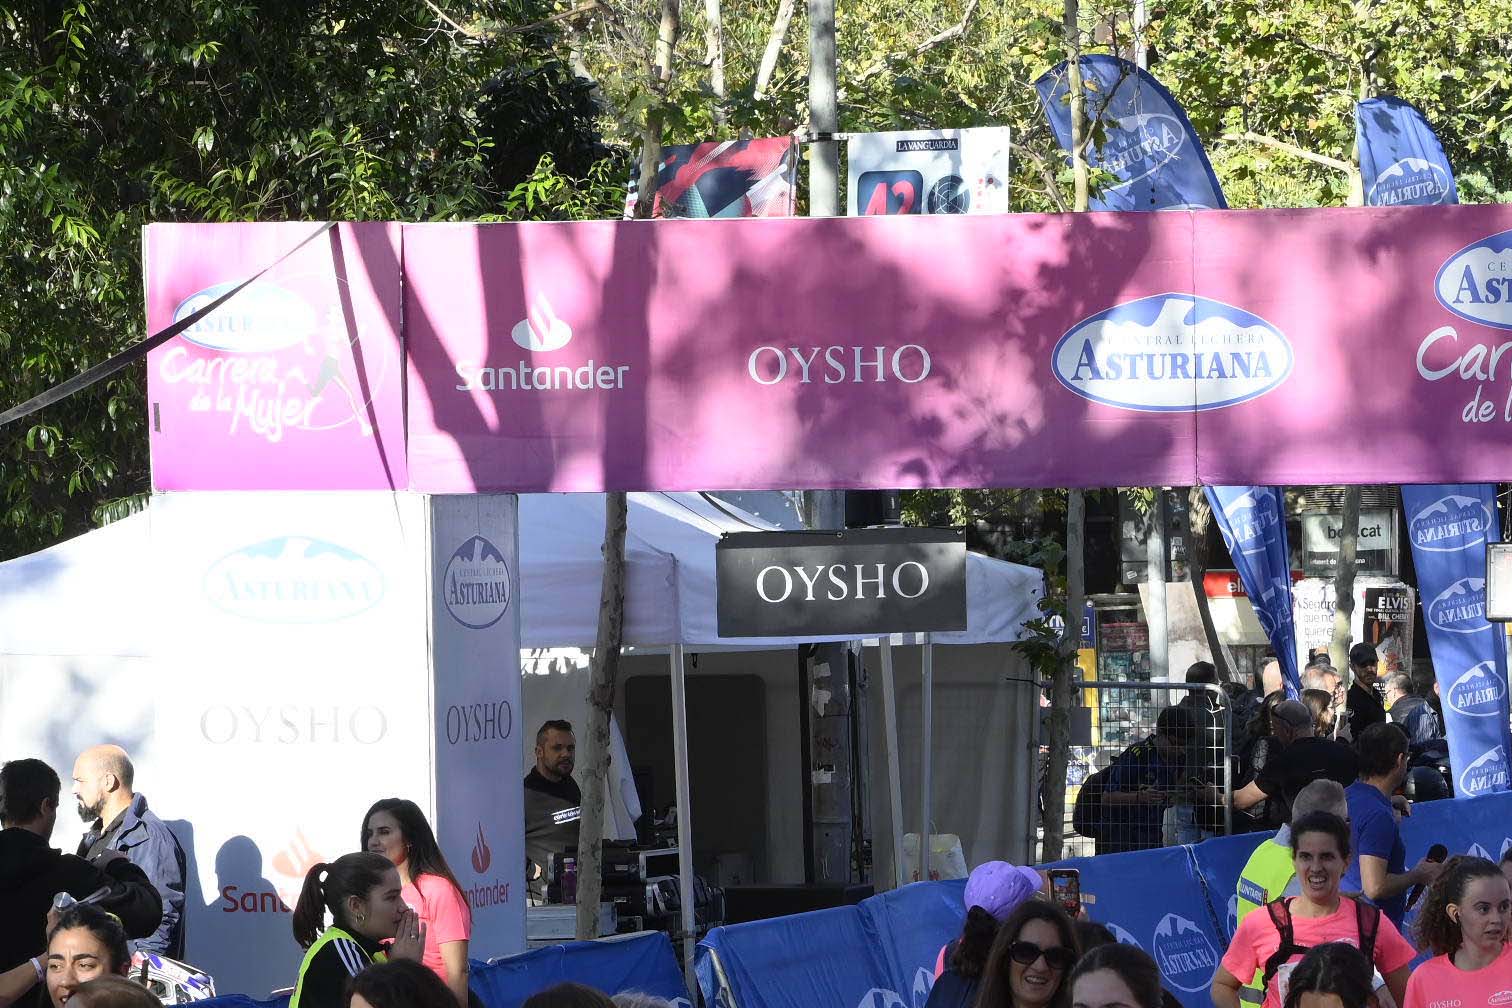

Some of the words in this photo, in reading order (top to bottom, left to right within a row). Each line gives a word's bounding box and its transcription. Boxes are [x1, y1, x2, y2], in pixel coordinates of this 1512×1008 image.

[1108, 334, 1183, 346] CENTRAL
[1190, 333, 1265, 346] LECHERA
[455, 360, 629, 391] Santander
[748, 344, 931, 385] OYSHO
[1071, 338, 1272, 382] ASTURIANA
[1462, 390, 1496, 423] de
[221, 569, 372, 602] ASTURIANA
[449, 571, 507, 605] ASTURIANA
[757, 560, 930, 603] OYSHO
[1378, 597, 1409, 609] ELVIS
[199, 703, 389, 745] OYSHO
[446, 700, 512, 745] OYSHO
[464, 881, 510, 910] antander
